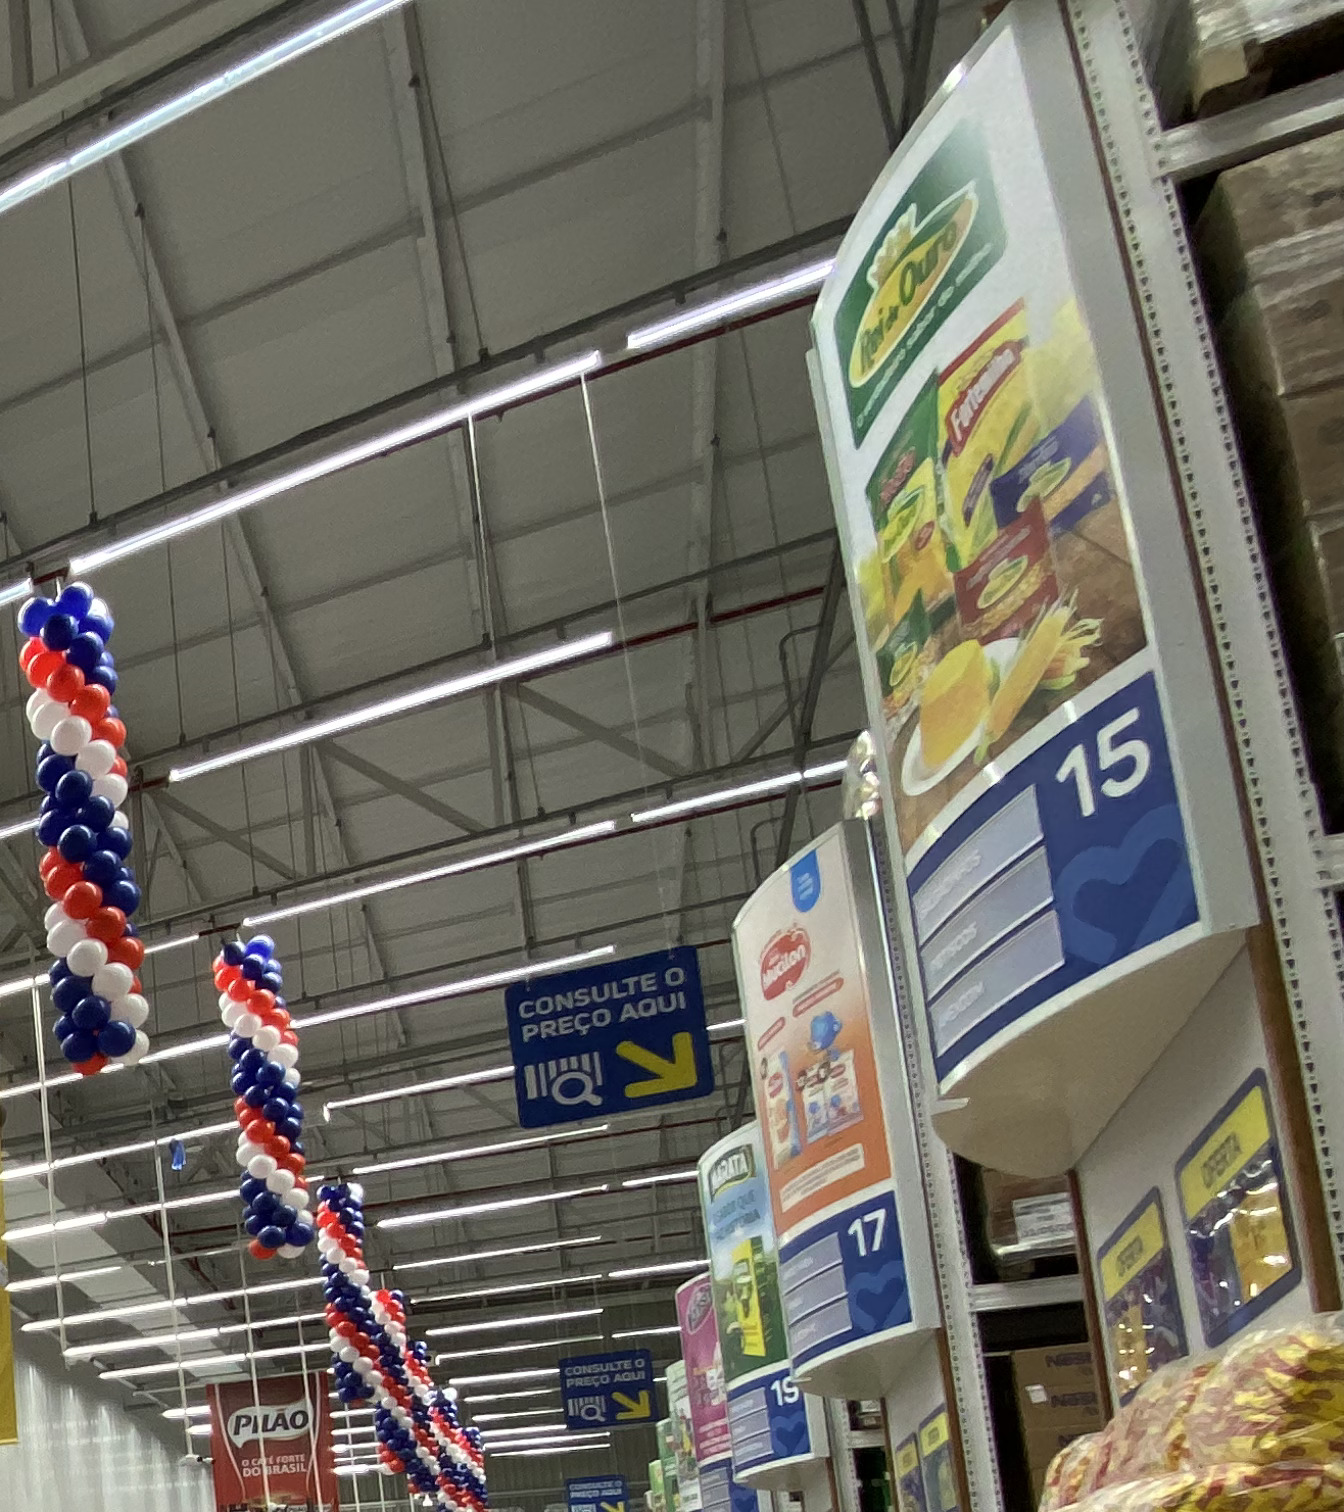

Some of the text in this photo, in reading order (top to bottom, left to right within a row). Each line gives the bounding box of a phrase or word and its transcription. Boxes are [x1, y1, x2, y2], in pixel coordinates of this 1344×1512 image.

[1055, 706, 1153, 817] 15
[518, 967, 686, 1019] CONSULTE O
[521, 991, 687, 1044] PREÇO AQUI
[847, 1208, 887, 1257] 17
[564, 1357, 645, 1376] CONSULTE O
[566, 1369, 646, 1388] PREÇO AQUI
[233, 1410, 309, 1436] PILÃO
[243, 1467, 259, 1478] DO
